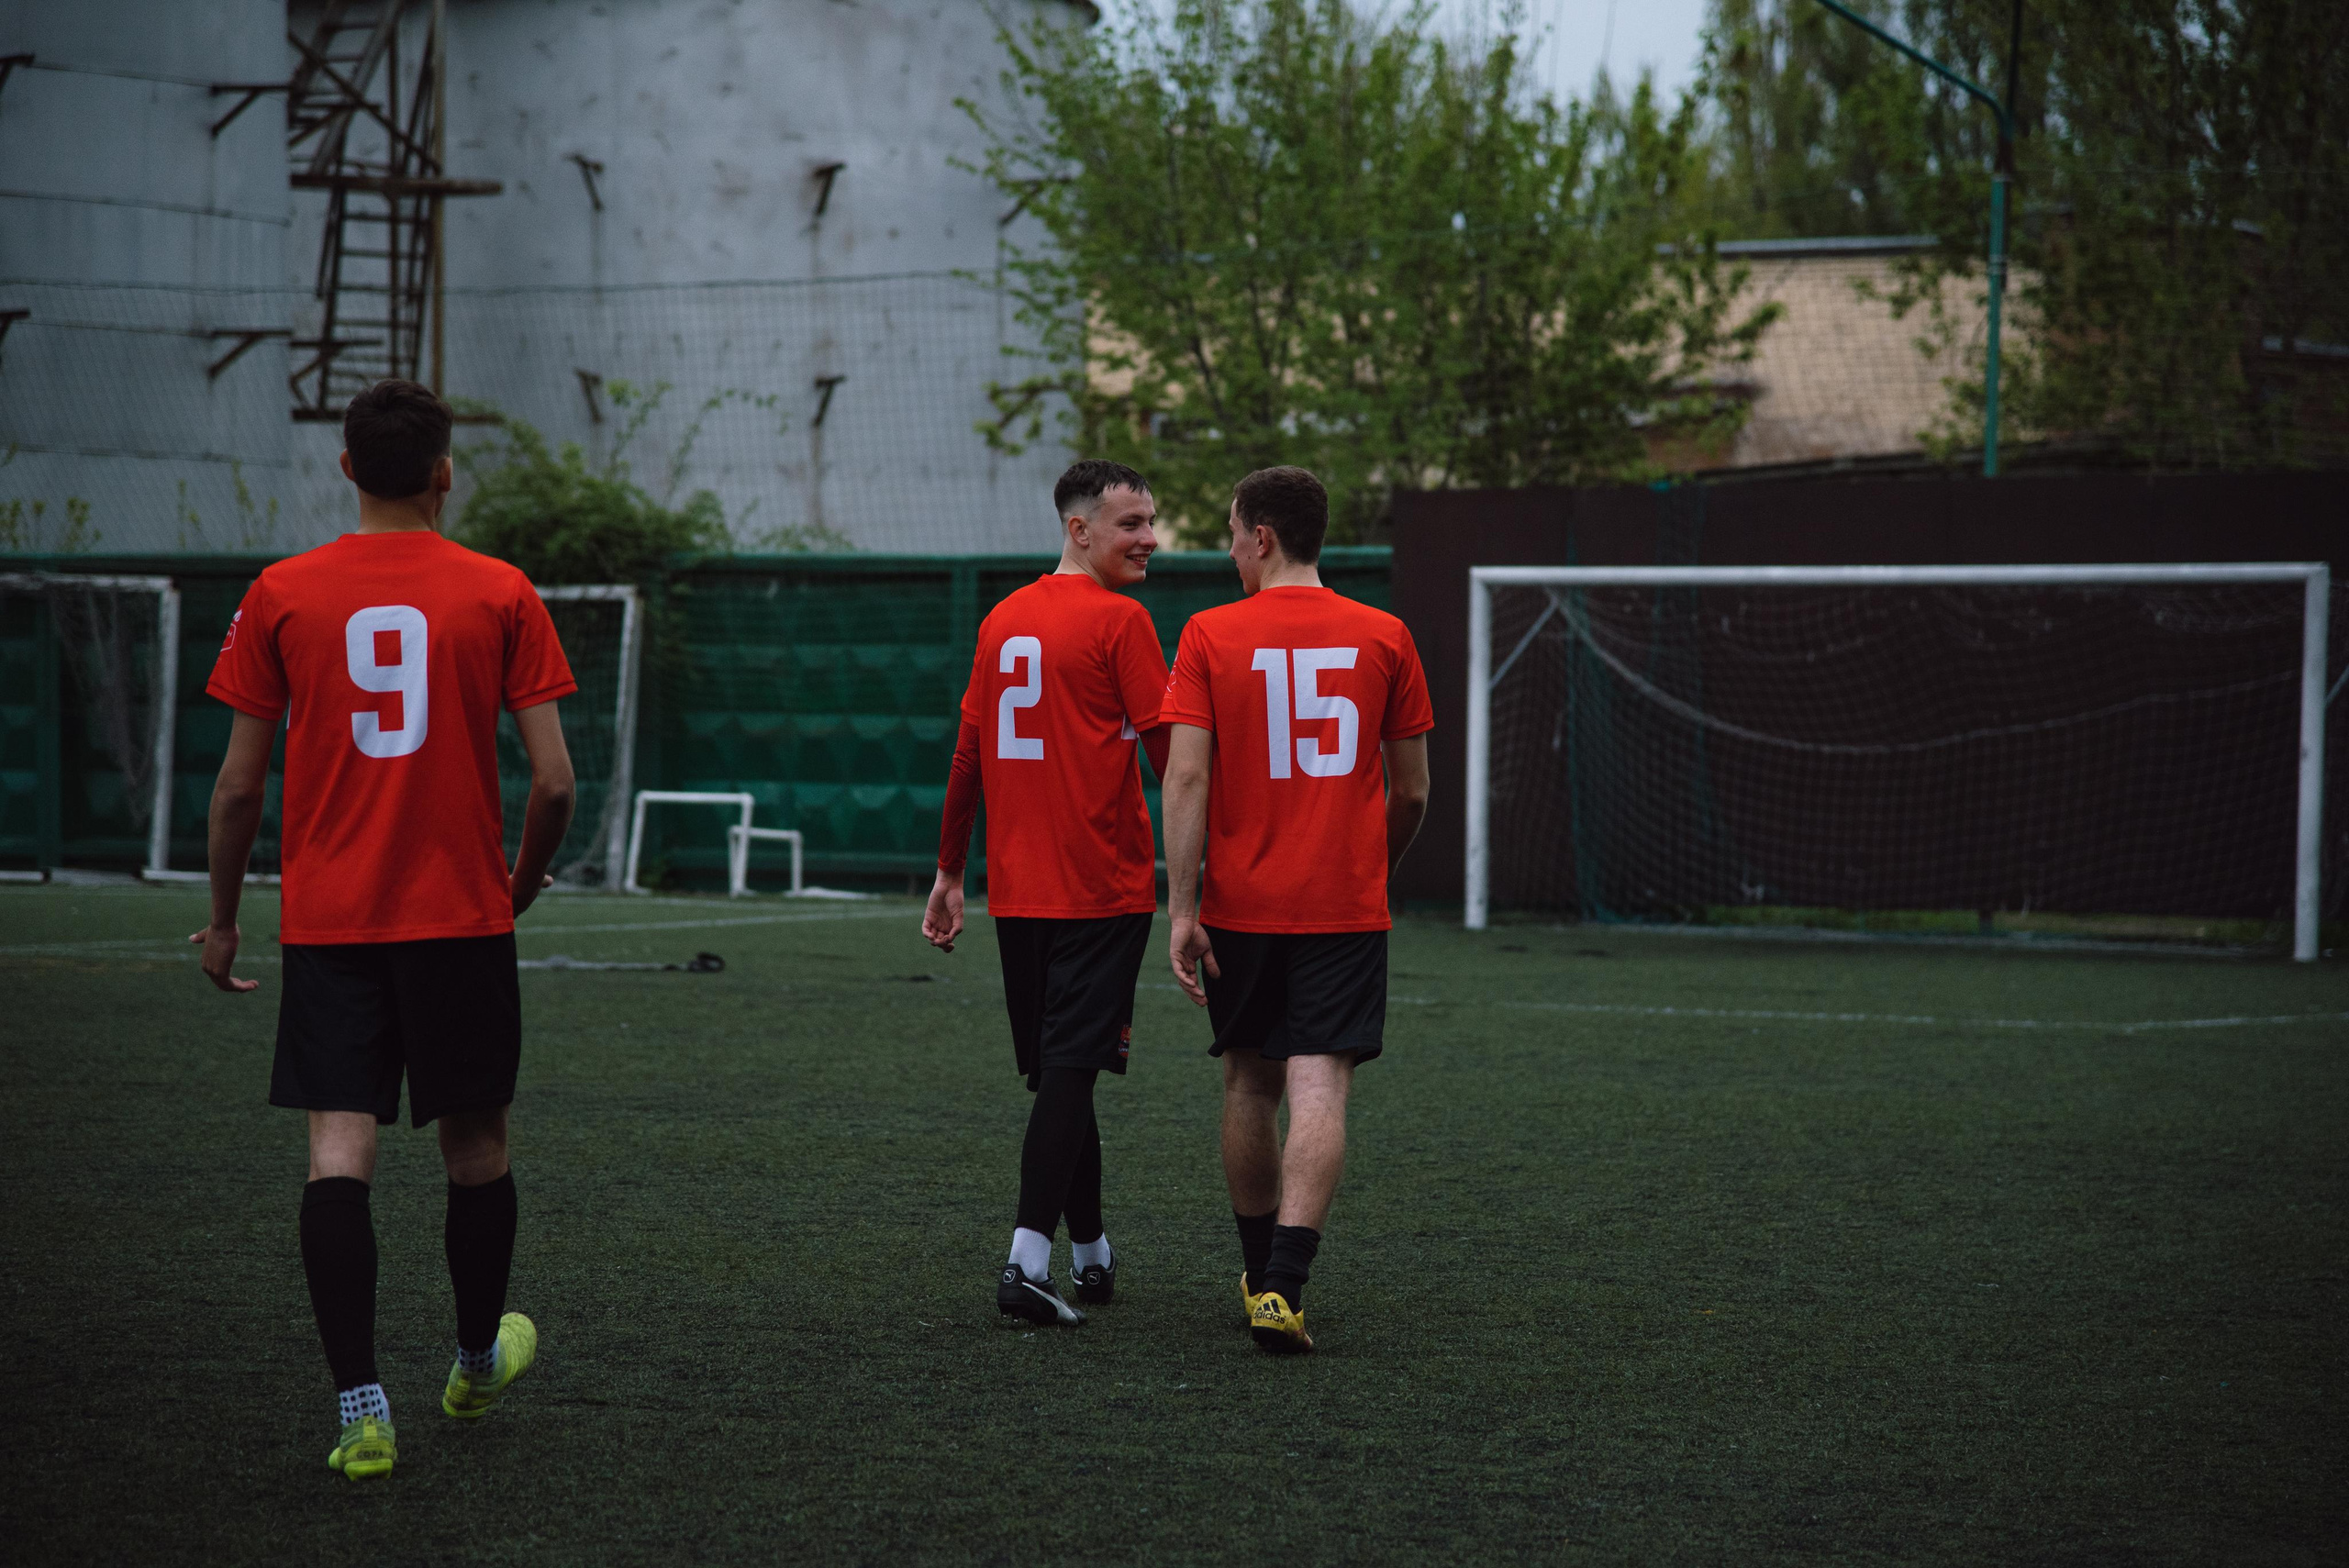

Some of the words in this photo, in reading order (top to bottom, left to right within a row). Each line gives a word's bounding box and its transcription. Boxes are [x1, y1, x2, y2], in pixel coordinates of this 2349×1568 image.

[345, 605, 429, 759] 9
[997, 636, 1044, 761] 2
[1251, 647, 1360, 779] 15
[1252, 1311, 1286, 1324] adidas
